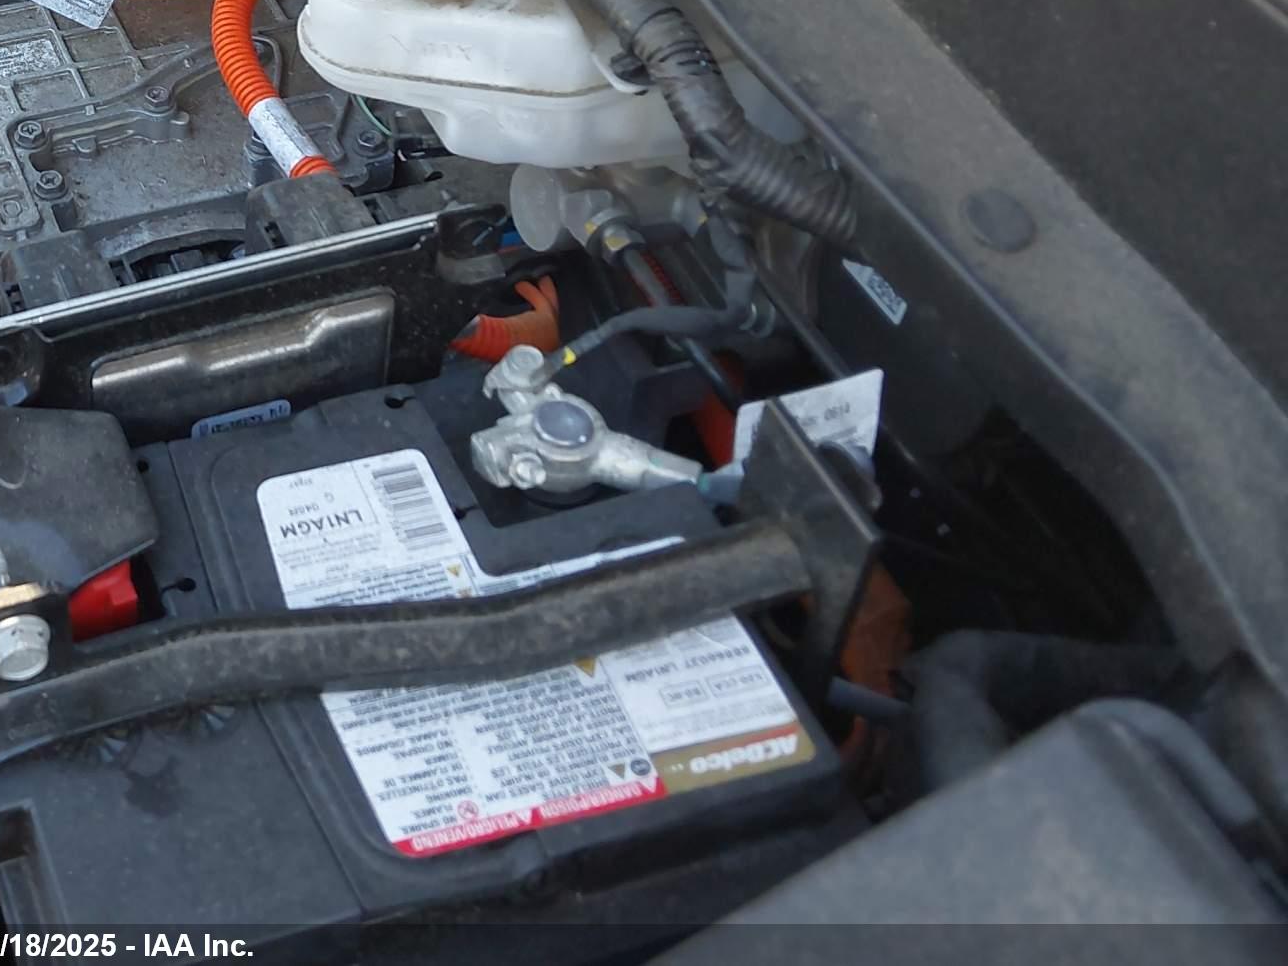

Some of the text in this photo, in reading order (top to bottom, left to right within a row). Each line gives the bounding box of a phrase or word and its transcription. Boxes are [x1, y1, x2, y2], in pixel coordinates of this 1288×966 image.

[279, 509, 363, 540] LN1AGM
[354, 739, 404, 756] CIGARROS
[689, 734, 798, 775] ACDelco
[423, 751, 458, 764] FUMER
[444, 774, 467, 785] PAS
[484, 767, 604, 802] EXPLOSIVE GASES CAN
[425, 785, 472, 802] SMOKING
